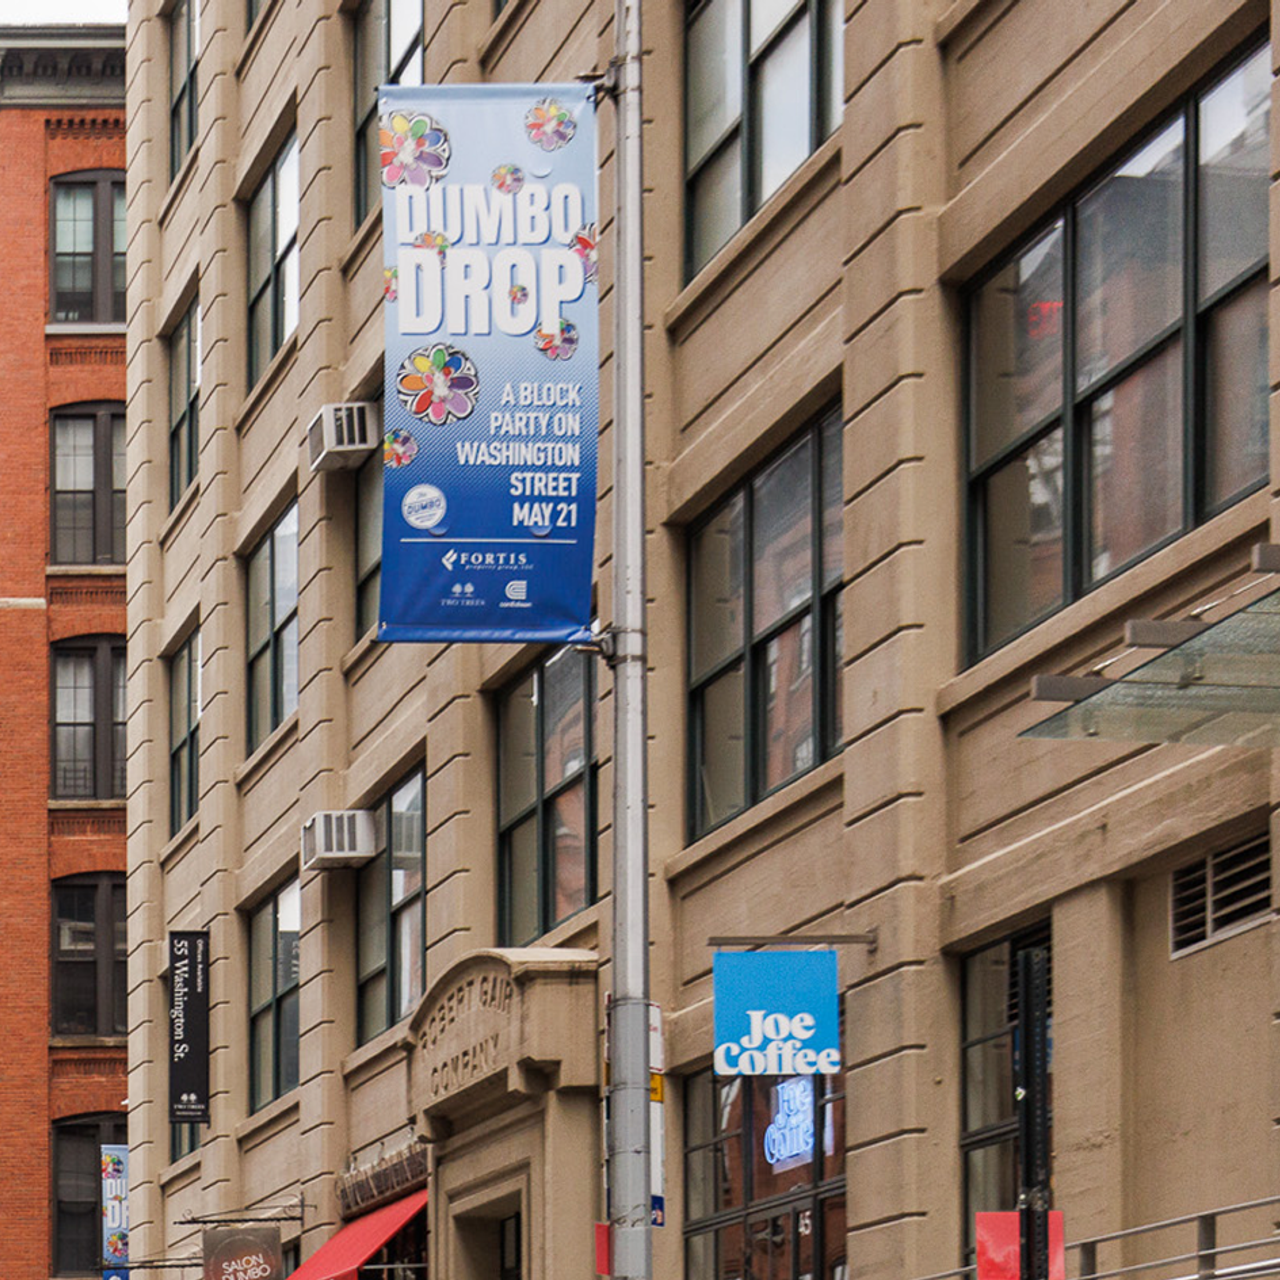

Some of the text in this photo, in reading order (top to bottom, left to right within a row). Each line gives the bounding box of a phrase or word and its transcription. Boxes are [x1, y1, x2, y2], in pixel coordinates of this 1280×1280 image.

[396, 183, 585, 247] DUMBO
[397, 249, 586, 336] DROP
[501, 383, 582, 406] A BLOCK
[490, 412, 580, 436] PARTY ON
[457, 442, 580, 466] WASHINGTON
[510, 472, 581, 496] STREET
[512, 502, 577, 527] MAY 21
[460, 553, 528, 565] FORTIS
[170, 940, 189, 1062] 55 Washington St.
[419, 975, 513, 1061] ROBERT GAIR
[740, 1010, 816, 1048] Joe
[431, 1033, 500, 1098] COMPANY
[714, 1040, 840, 1075] Coffee
[774, 1080, 811, 1128] Joe
[221, 1253, 265, 1274] SALON
